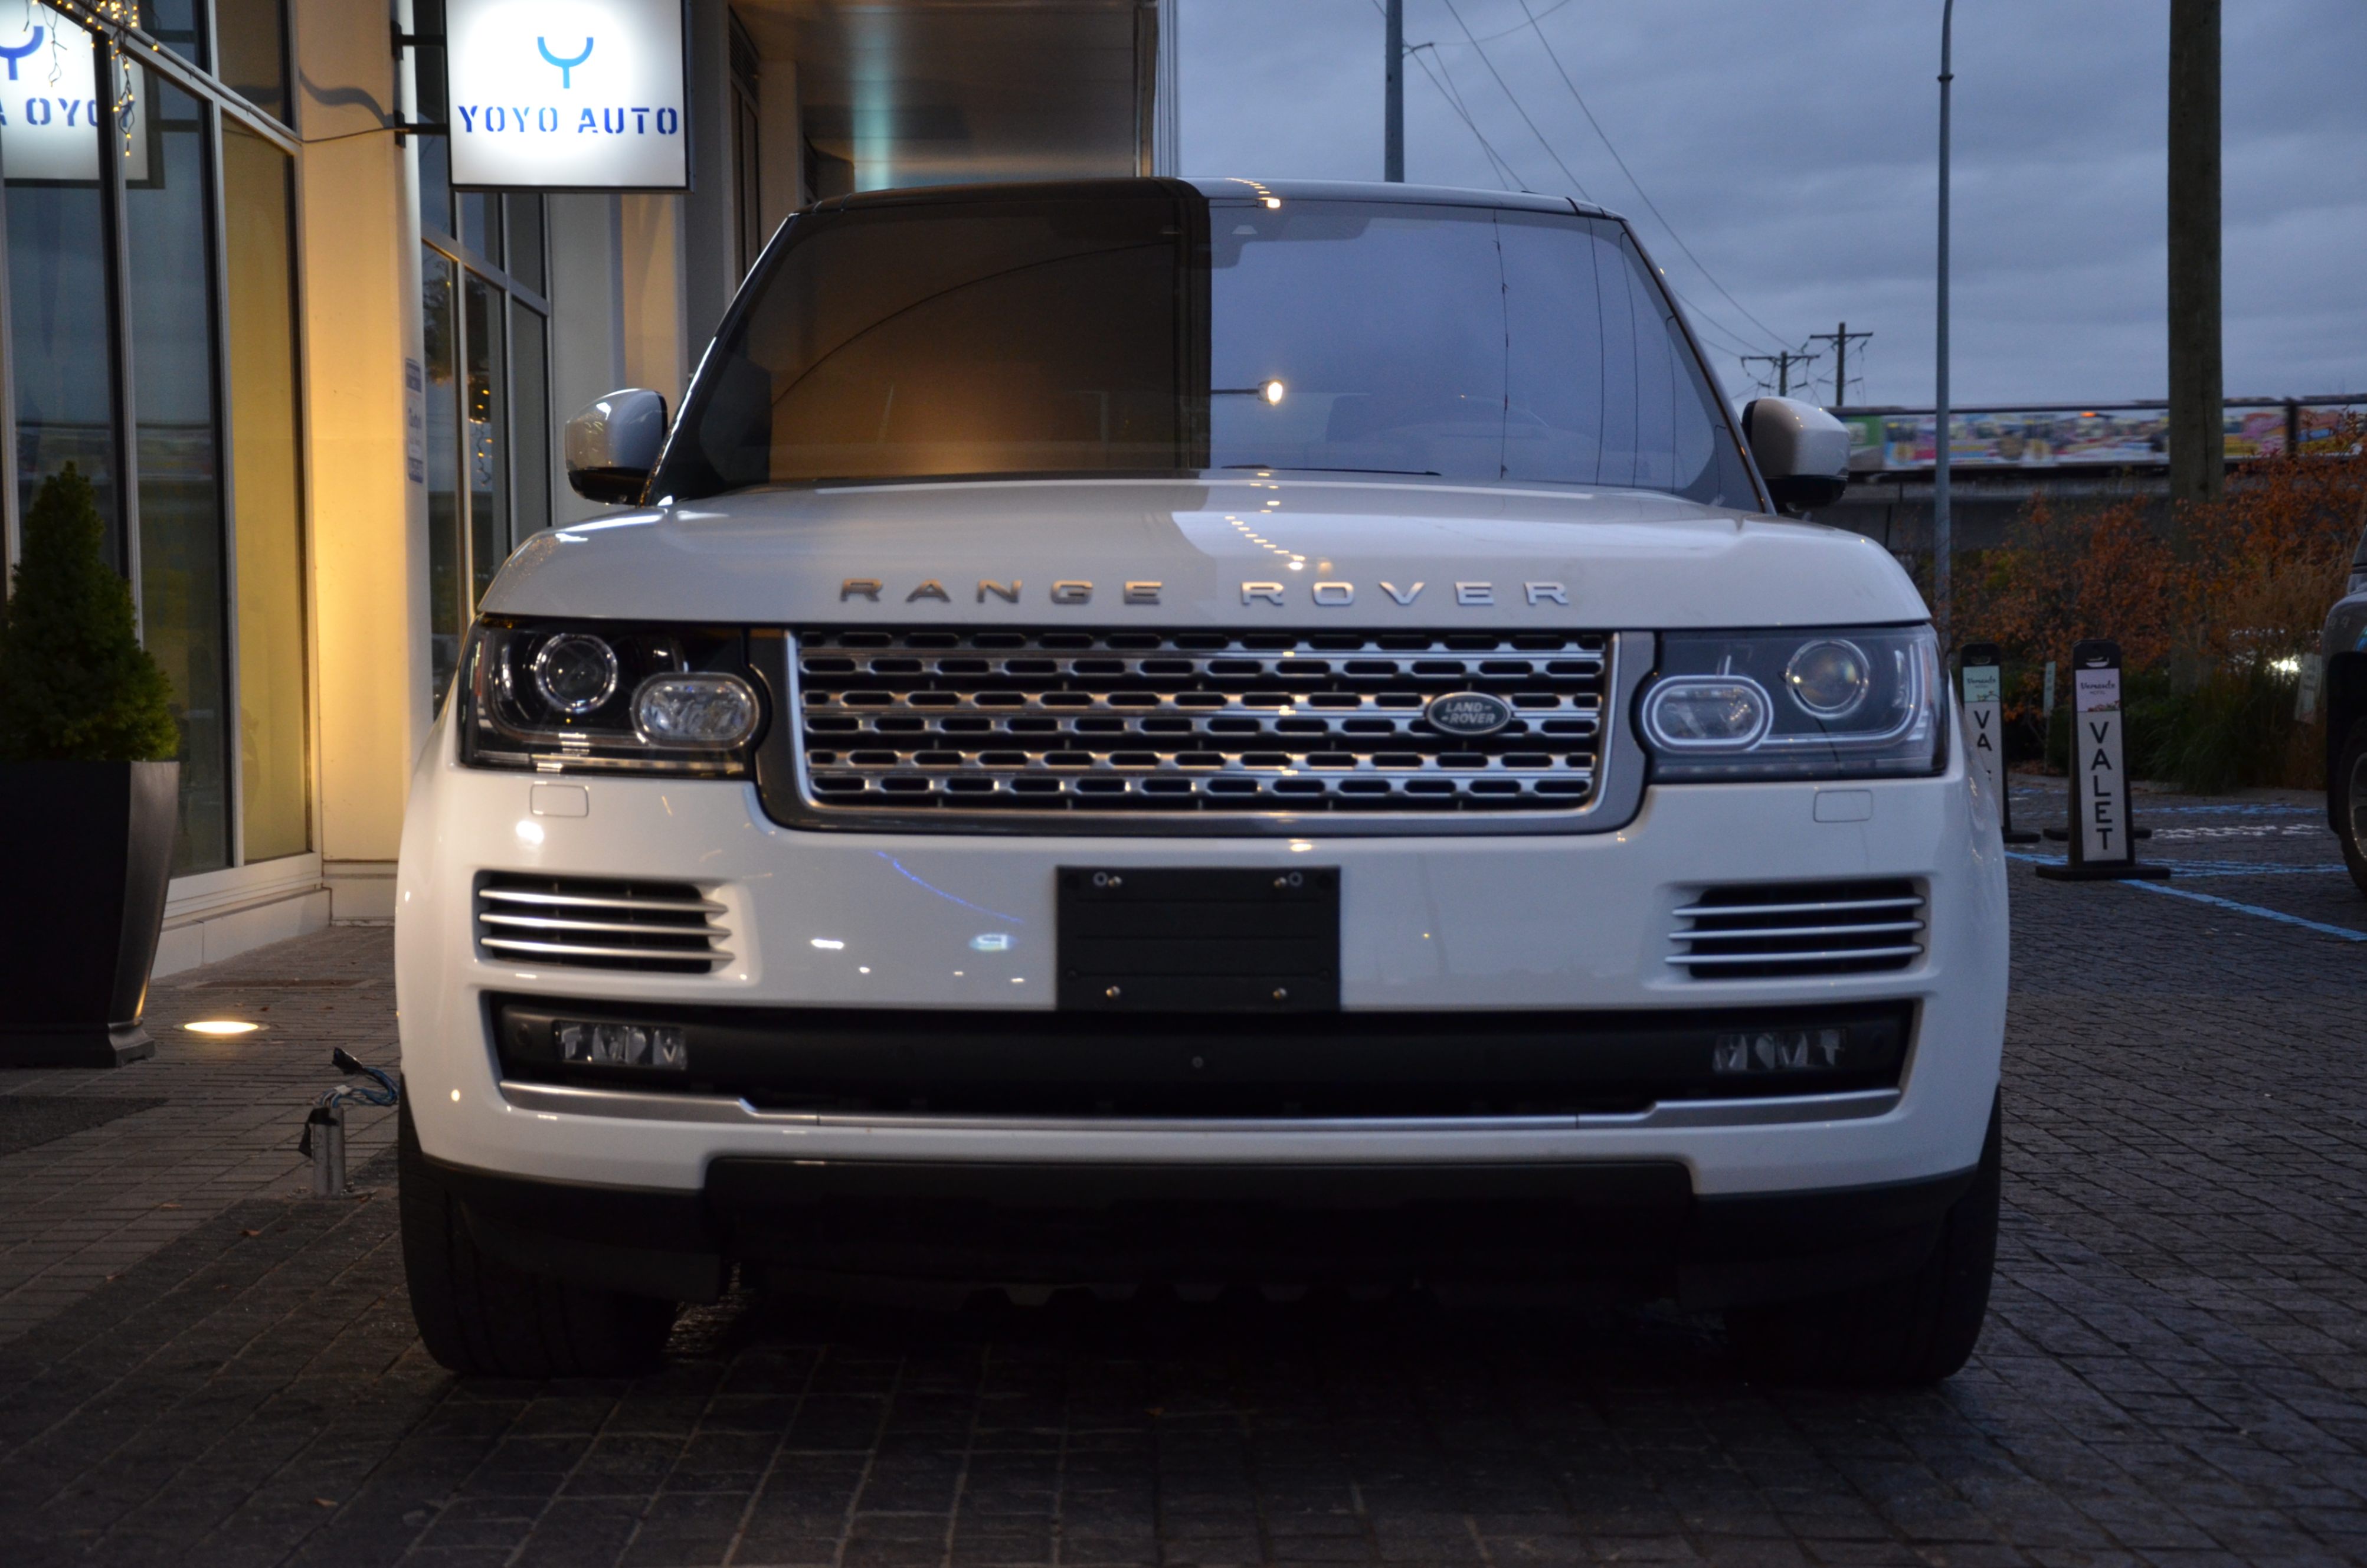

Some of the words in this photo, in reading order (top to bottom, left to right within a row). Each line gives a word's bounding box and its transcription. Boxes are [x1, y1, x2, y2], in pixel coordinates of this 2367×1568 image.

[457, 105, 558, 132] YOYO
[577, 107, 678, 135] AUTO
[839, 578, 1163, 605] RANGE
[1240, 581, 1569, 606] ROVER
[1445, 702, 1484, 712] LAND
[1449, 713, 1496, 724] ROVER
[2089, 721, 2113, 850] VALET
